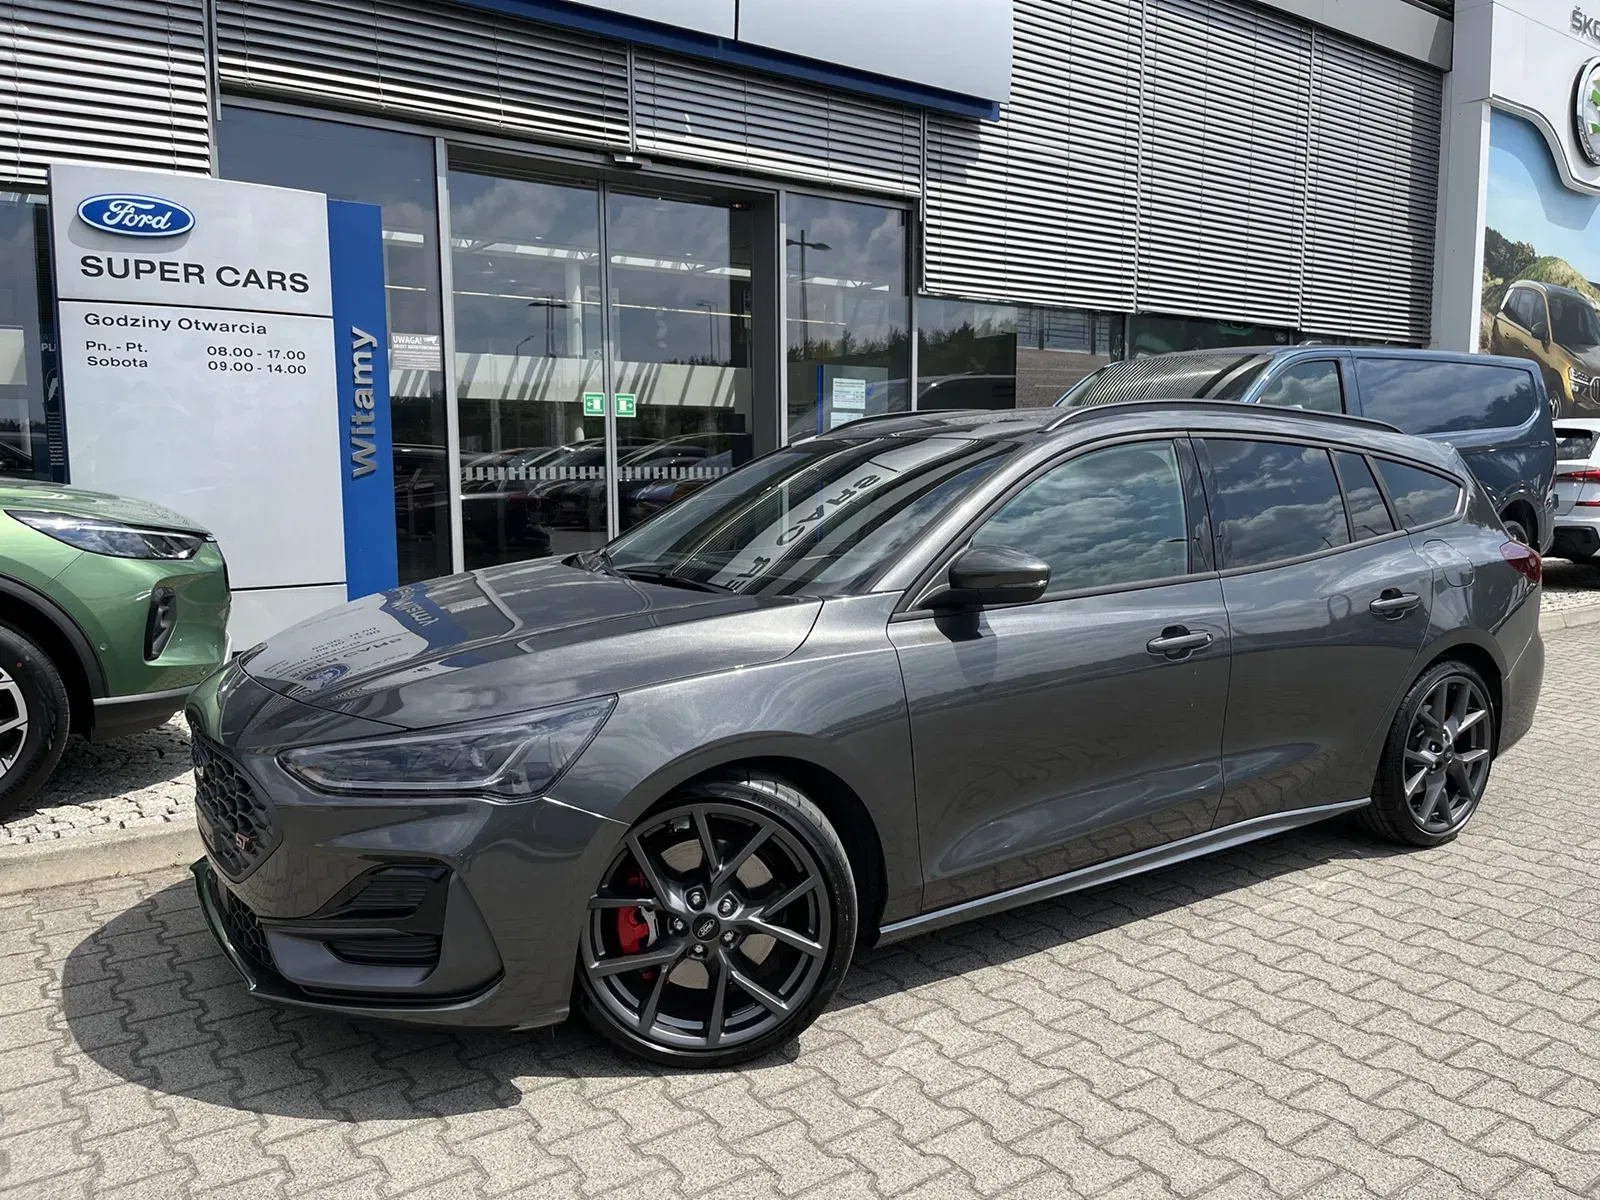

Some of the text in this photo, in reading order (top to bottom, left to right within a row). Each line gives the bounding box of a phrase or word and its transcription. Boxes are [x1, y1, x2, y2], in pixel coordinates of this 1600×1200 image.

[103, 200, 172, 229] Ford
[81, 255, 309, 292] SUPER CARS
[84, 313, 267, 335] Godziny Otwarcia
[86, 341, 112, 351] Pn.
[126, 343, 148, 352] Pt.
[207, 346, 254, 357] 08.00
[267, 350, 306, 360] 17.00
[392, 335, 422, 345] UWAGA!
[87, 356, 148, 368] Sobota
[208, 361, 254, 371] 09.00
[267, 364, 307, 374] 14.00
[351, 325, 377, 478] Witamy
